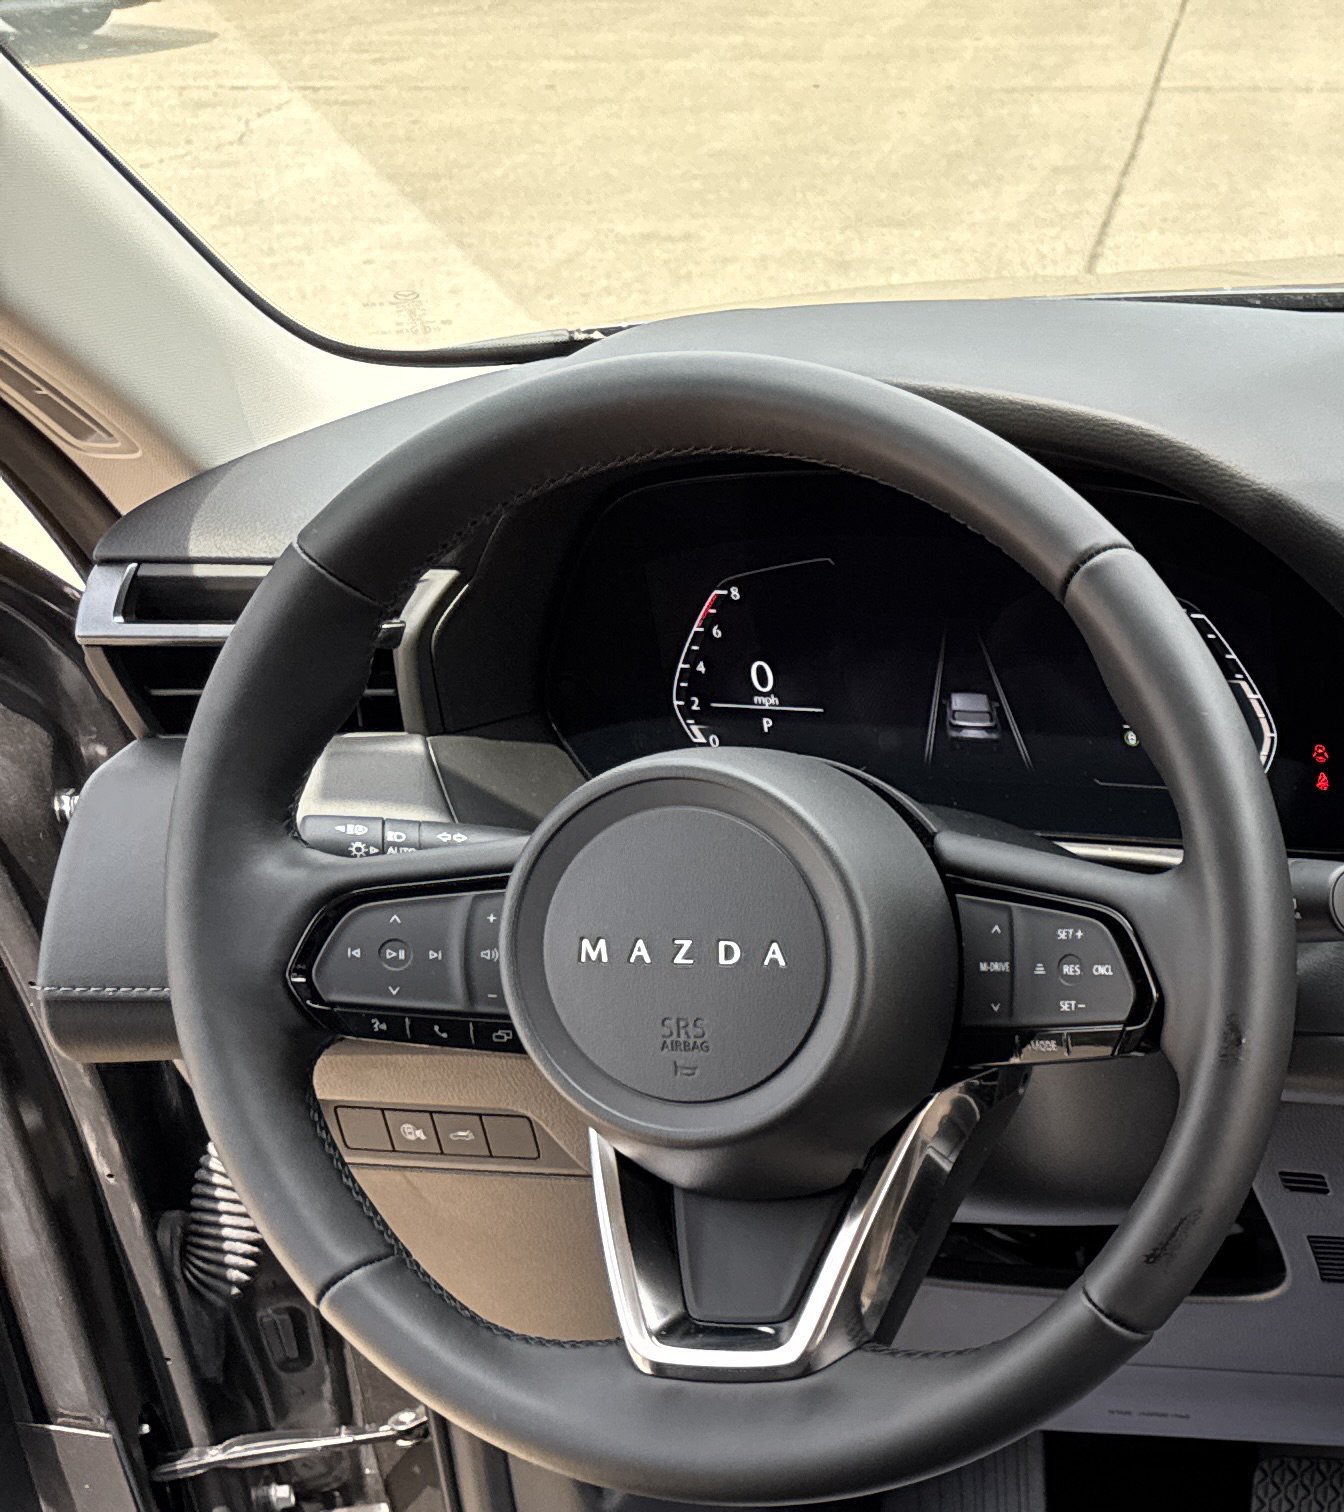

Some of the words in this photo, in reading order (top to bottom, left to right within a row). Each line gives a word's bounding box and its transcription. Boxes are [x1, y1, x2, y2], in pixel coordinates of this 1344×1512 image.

[730, 586, 741, 600] 8
[712, 625, 722, 638] 6
[696, 661, 706, 675] 4
[750, 660, 774, 693] 0
[690, 697, 700, 711] 2
[753, 694, 780, 708] mph
[762, 717, 773, 733] P
[708, 734, 720, 748] 0
[579, 936, 787, 968] MAZDA
[1062, 964, 1080, 975] RES
[1092, 964, 1113, 976] CNCL
[661, 1017, 706, 1039] SRS
[661, 1040, 710, 1052] AIRBAG
